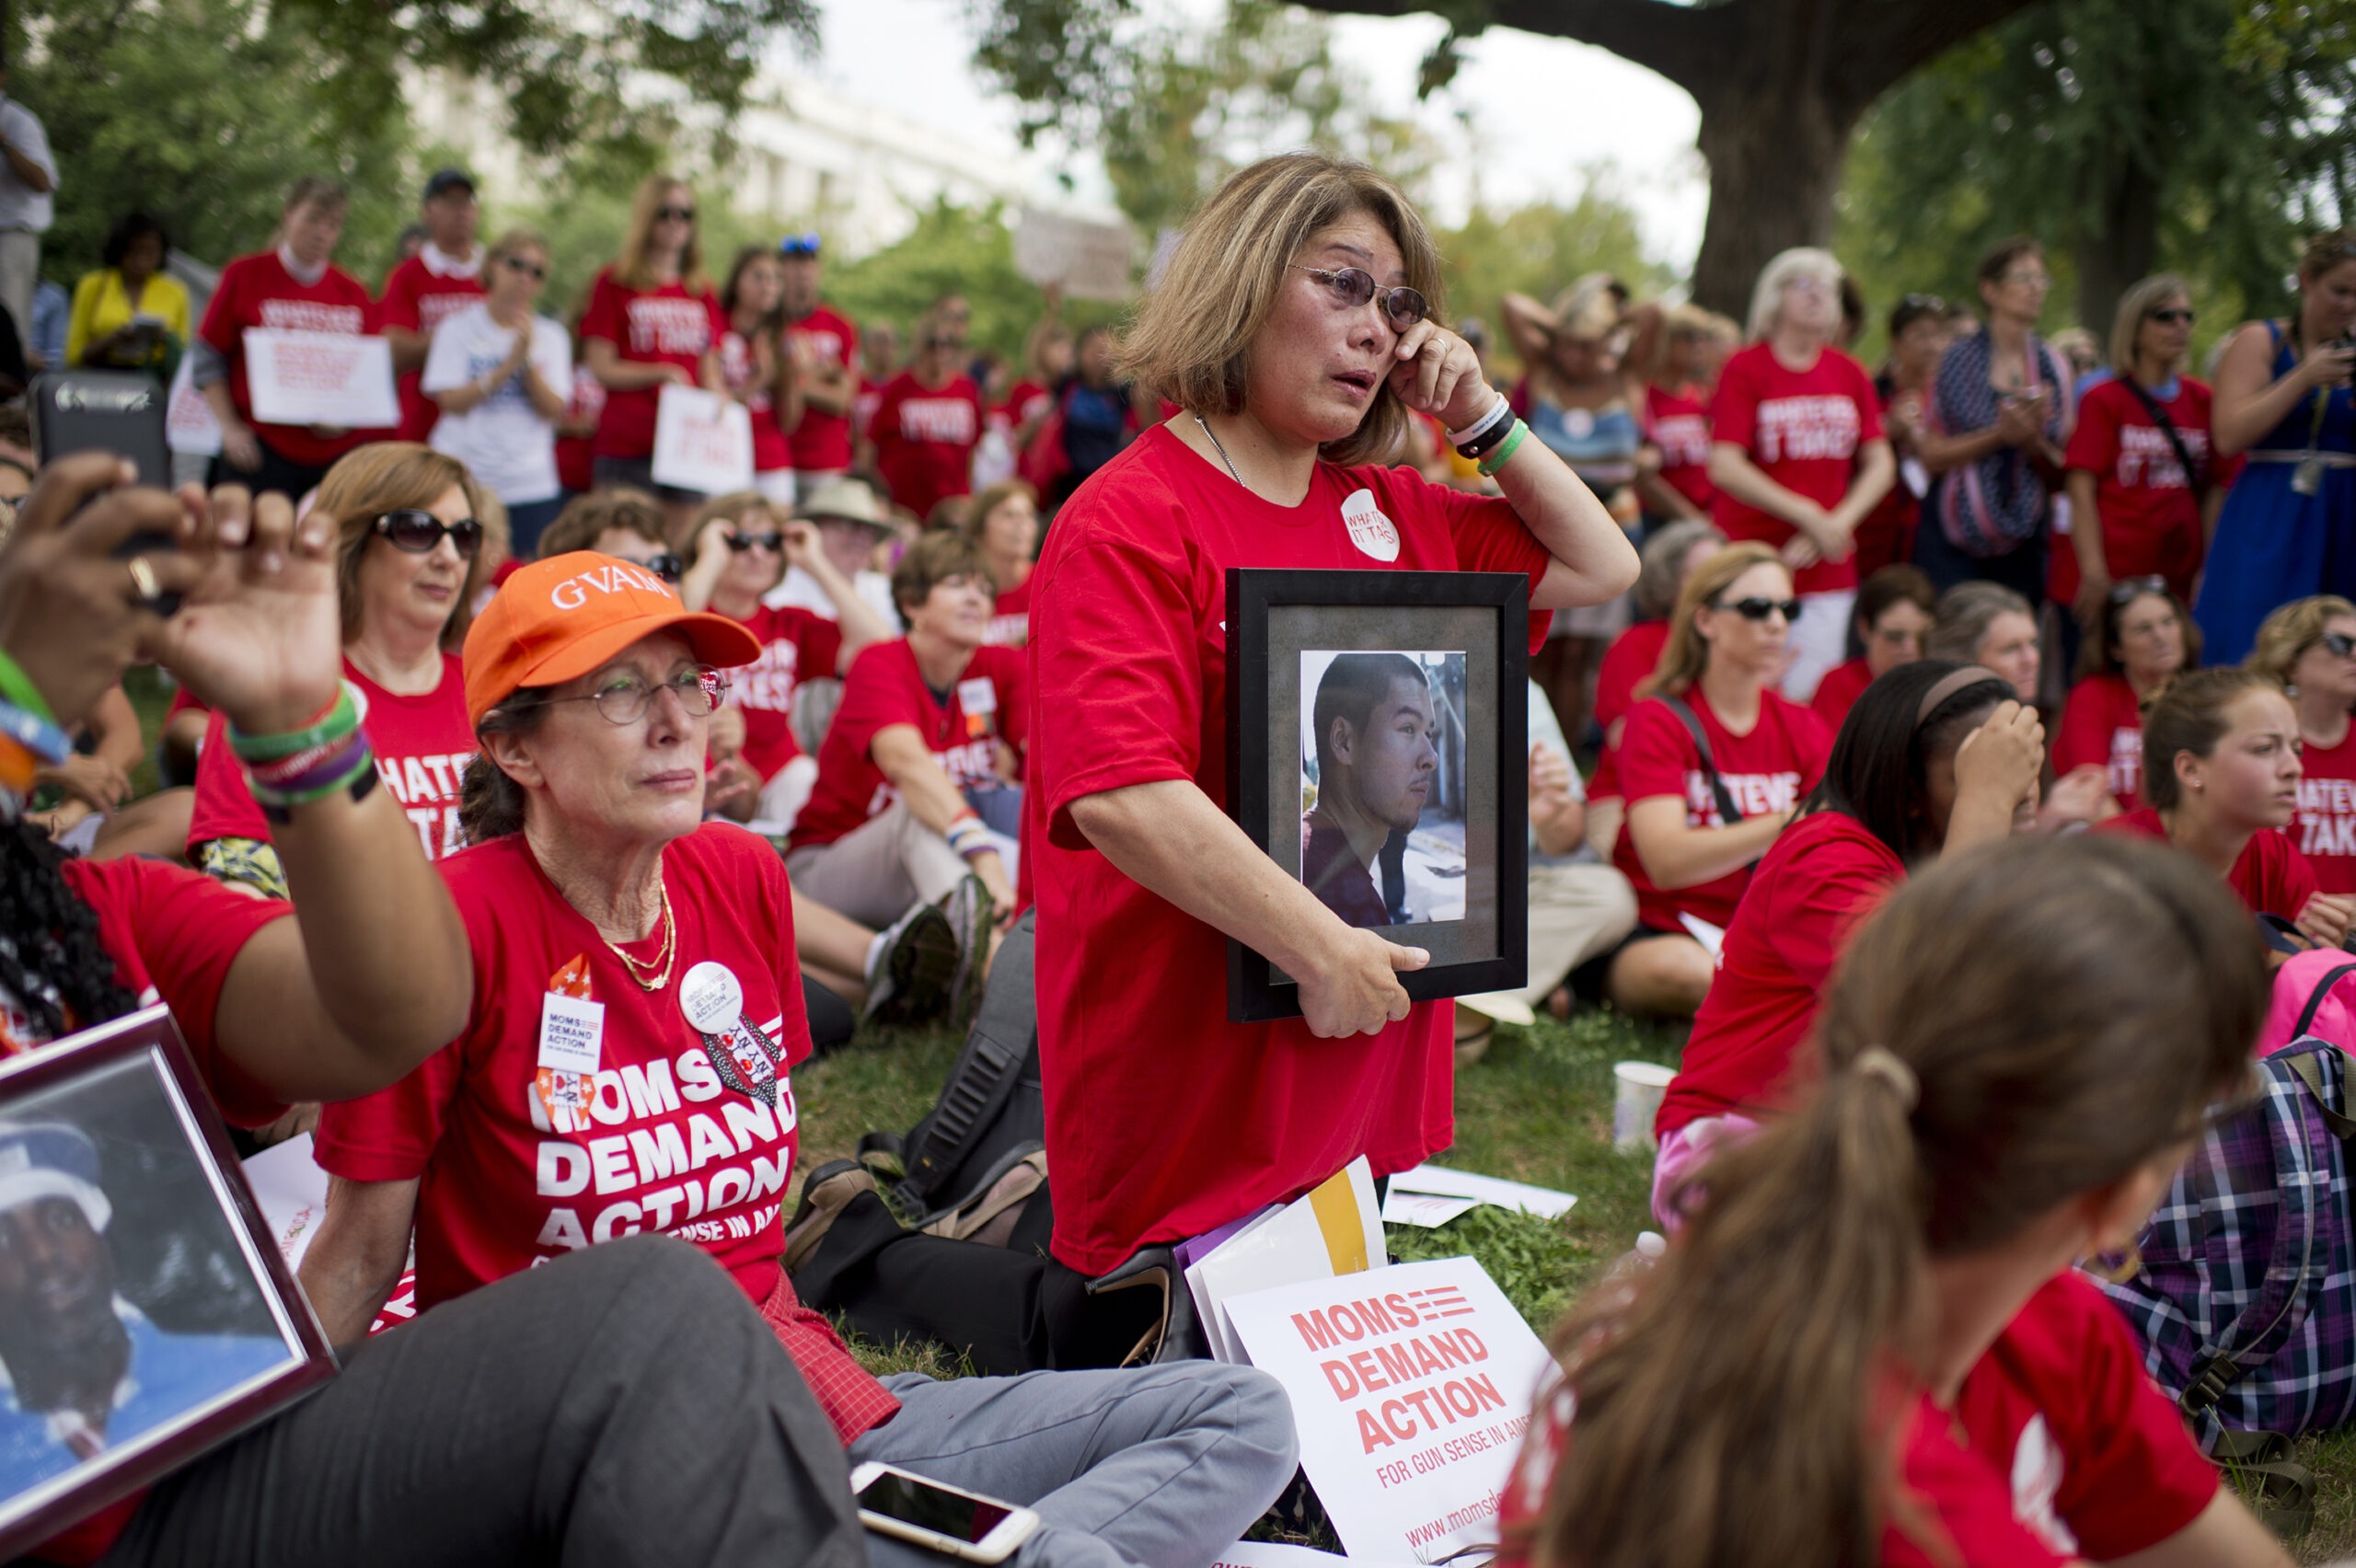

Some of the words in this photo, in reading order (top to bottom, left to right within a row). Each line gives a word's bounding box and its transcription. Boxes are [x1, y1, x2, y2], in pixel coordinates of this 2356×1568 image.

[547, 1034, 585, 1048] ACTION
[548, 1024, 592, 1040] DEMAND
[549, 1013, 581, 1028] MOMS
[537, 1077, 797, 1197] DEMAND
[536, 1147, 790, 1252] ACTION
[723, 1215, 751, 1239] IN
[1289, 1293, 1420, 1352] MOMS
[1319, 1328, 1489, 1402] DEMAND
[1356, 1373, 1507, 1455] ACTION
[1376, 1459, 1412, 1489] FOR
[1411, 1447, 1447, 1474] GUN
[1444, 1431, 1492, 1461] SENSE
[1486, 1425, 1507, 1446] IN
